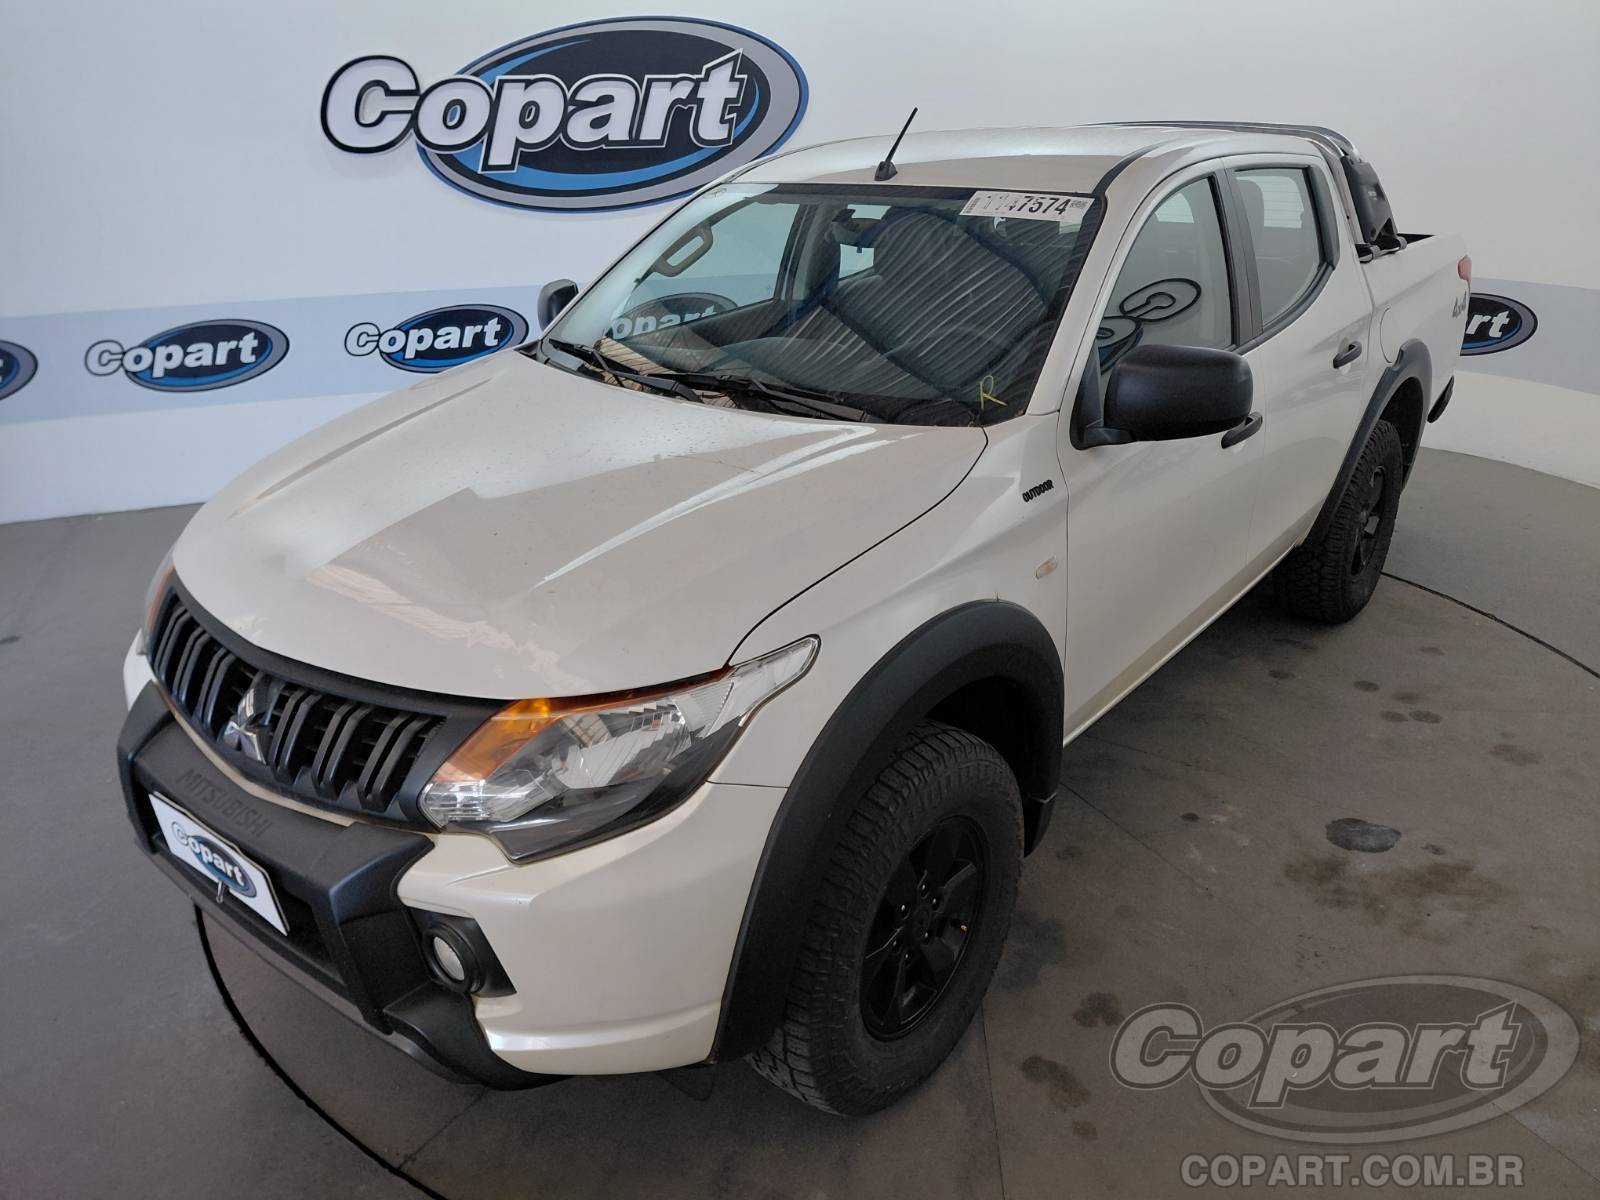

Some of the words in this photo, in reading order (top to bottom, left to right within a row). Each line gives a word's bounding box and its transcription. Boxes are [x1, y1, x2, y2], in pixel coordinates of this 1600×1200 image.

[321, 48, 747, 173] Copart
[86, 331, 258, 377] Copart
[345, 317, 501, 359] Copart
[1022, 479, 1054, 502] OUTDOOR
[176, 768, 272, 837] MITSUBISHI
[171, 821, 245, 887] Copart
